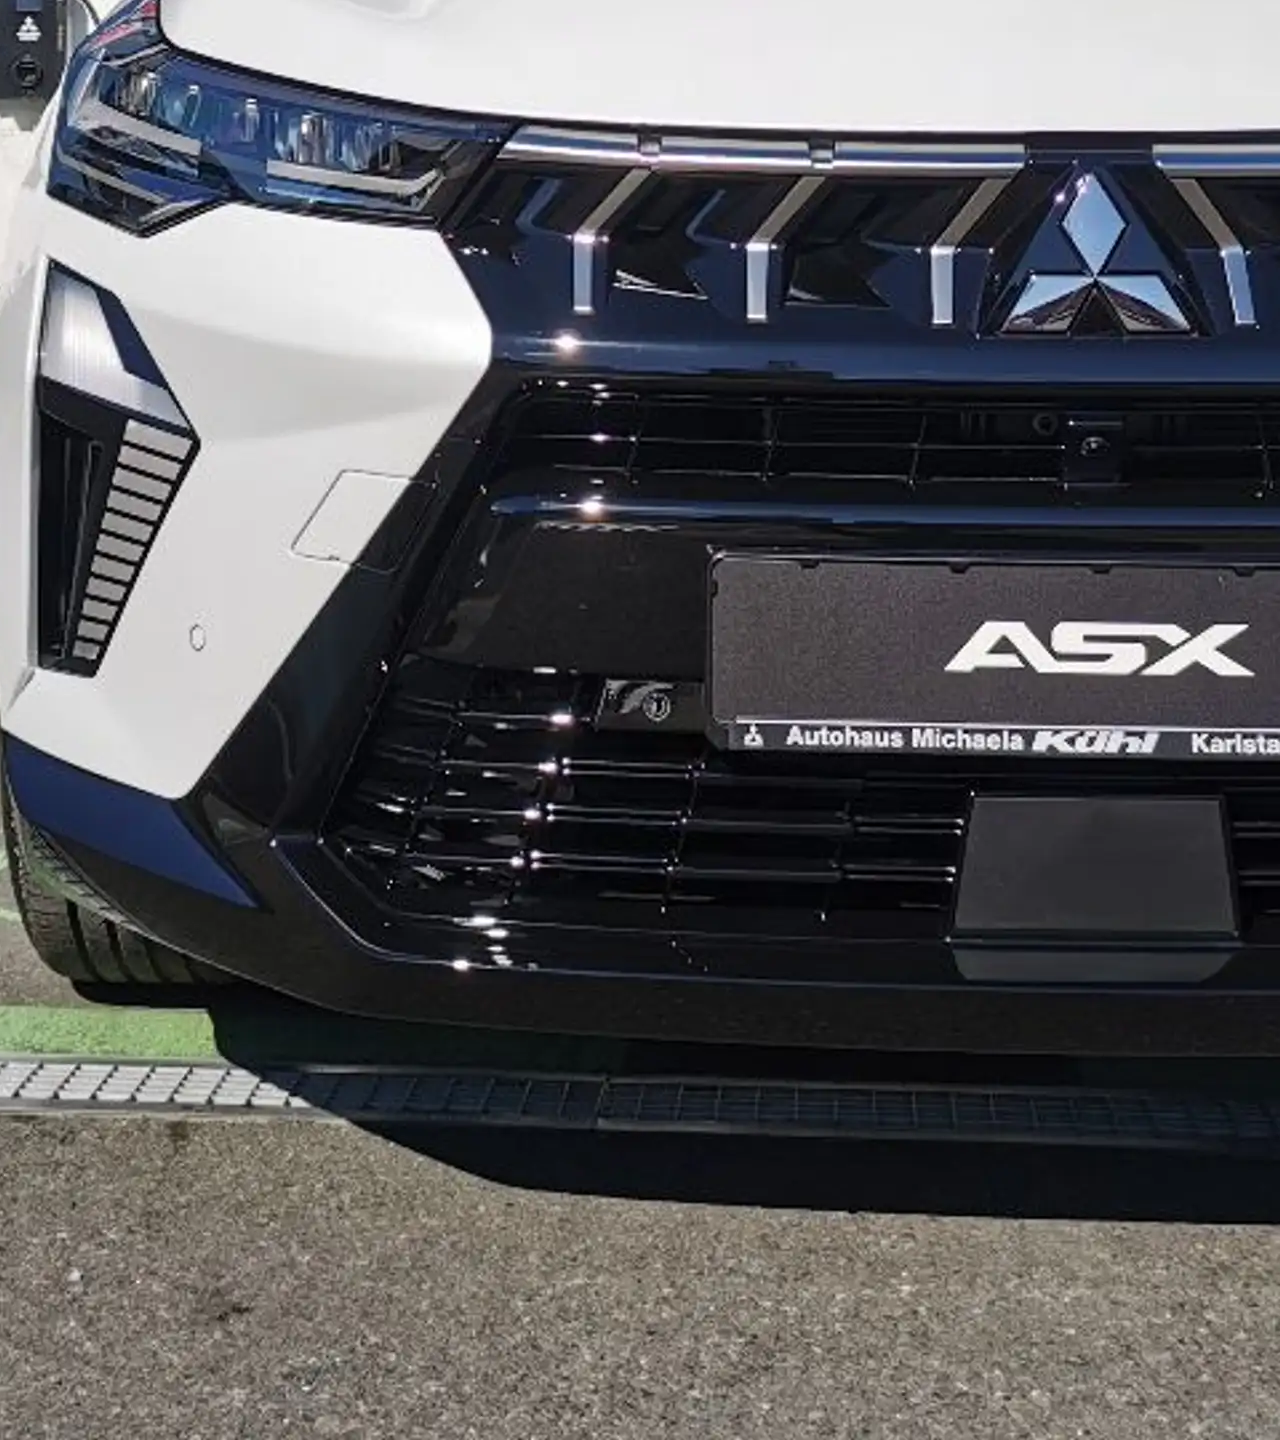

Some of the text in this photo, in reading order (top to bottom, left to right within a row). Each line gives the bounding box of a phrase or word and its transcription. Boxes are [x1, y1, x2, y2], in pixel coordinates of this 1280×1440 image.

[943, 620, 1256, 678] ASX
[786, 724, 903, 750] Autohaus
[912, 726, 1025, 752] Michaela
[1031, 729, 1161, 755] Kühl
